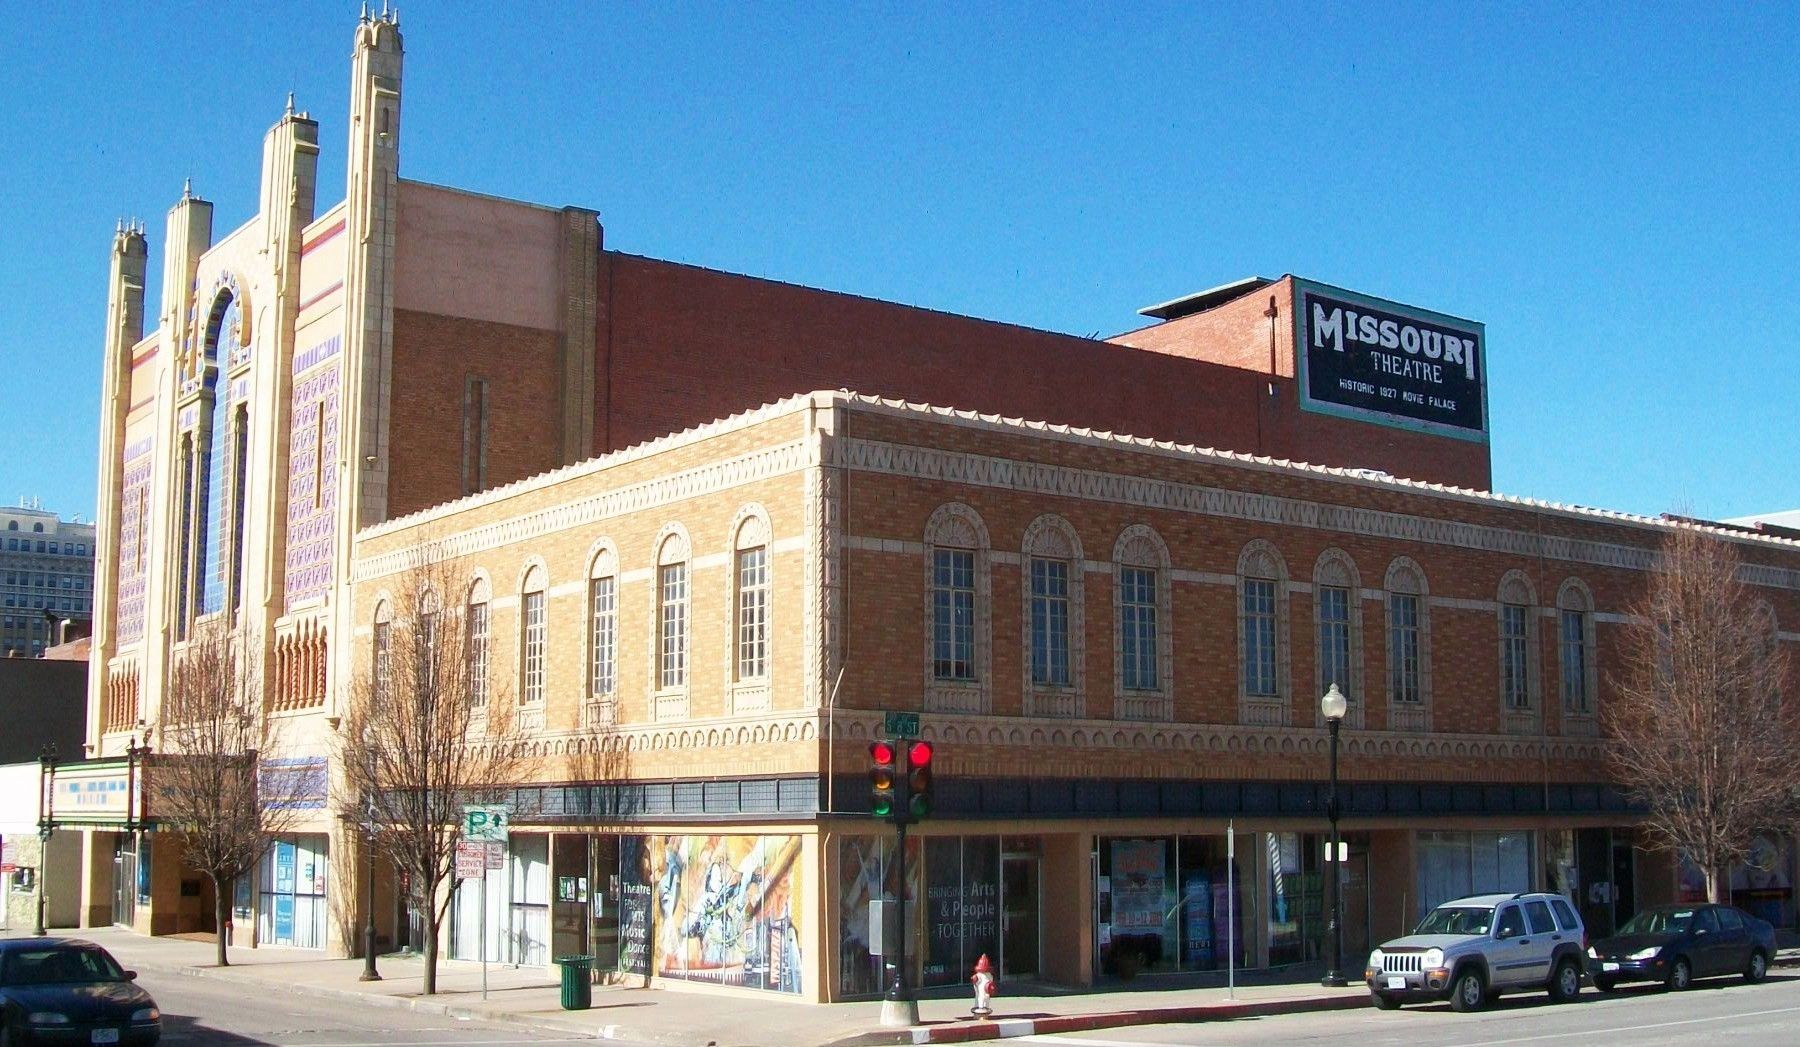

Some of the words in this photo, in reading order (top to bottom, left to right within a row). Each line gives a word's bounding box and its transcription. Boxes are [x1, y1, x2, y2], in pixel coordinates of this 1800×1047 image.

[1313, 302, 1475, 381] MISSOURI
[1371, 351, 1443, 384] THEATRE
[1339, 378, 1375, 395] HISTORIC
[1380, 386, 1397, 399] 1927
[1402, 391, 1424, 405] MOVIE
[1428, 396, 1457, 411] PALACE
[469, 811, 488, 836] P
[622, 881, 651, 895] Theatre
[928, 886, 968, 899] BRINGING
[971, 881, 995, 897] Arts
[940, 901, 950, 917] &
[953, 899, 995, 919] People
[621, 924, 646, 938] Music
[938, 921, 995, 939] TOGETHER
